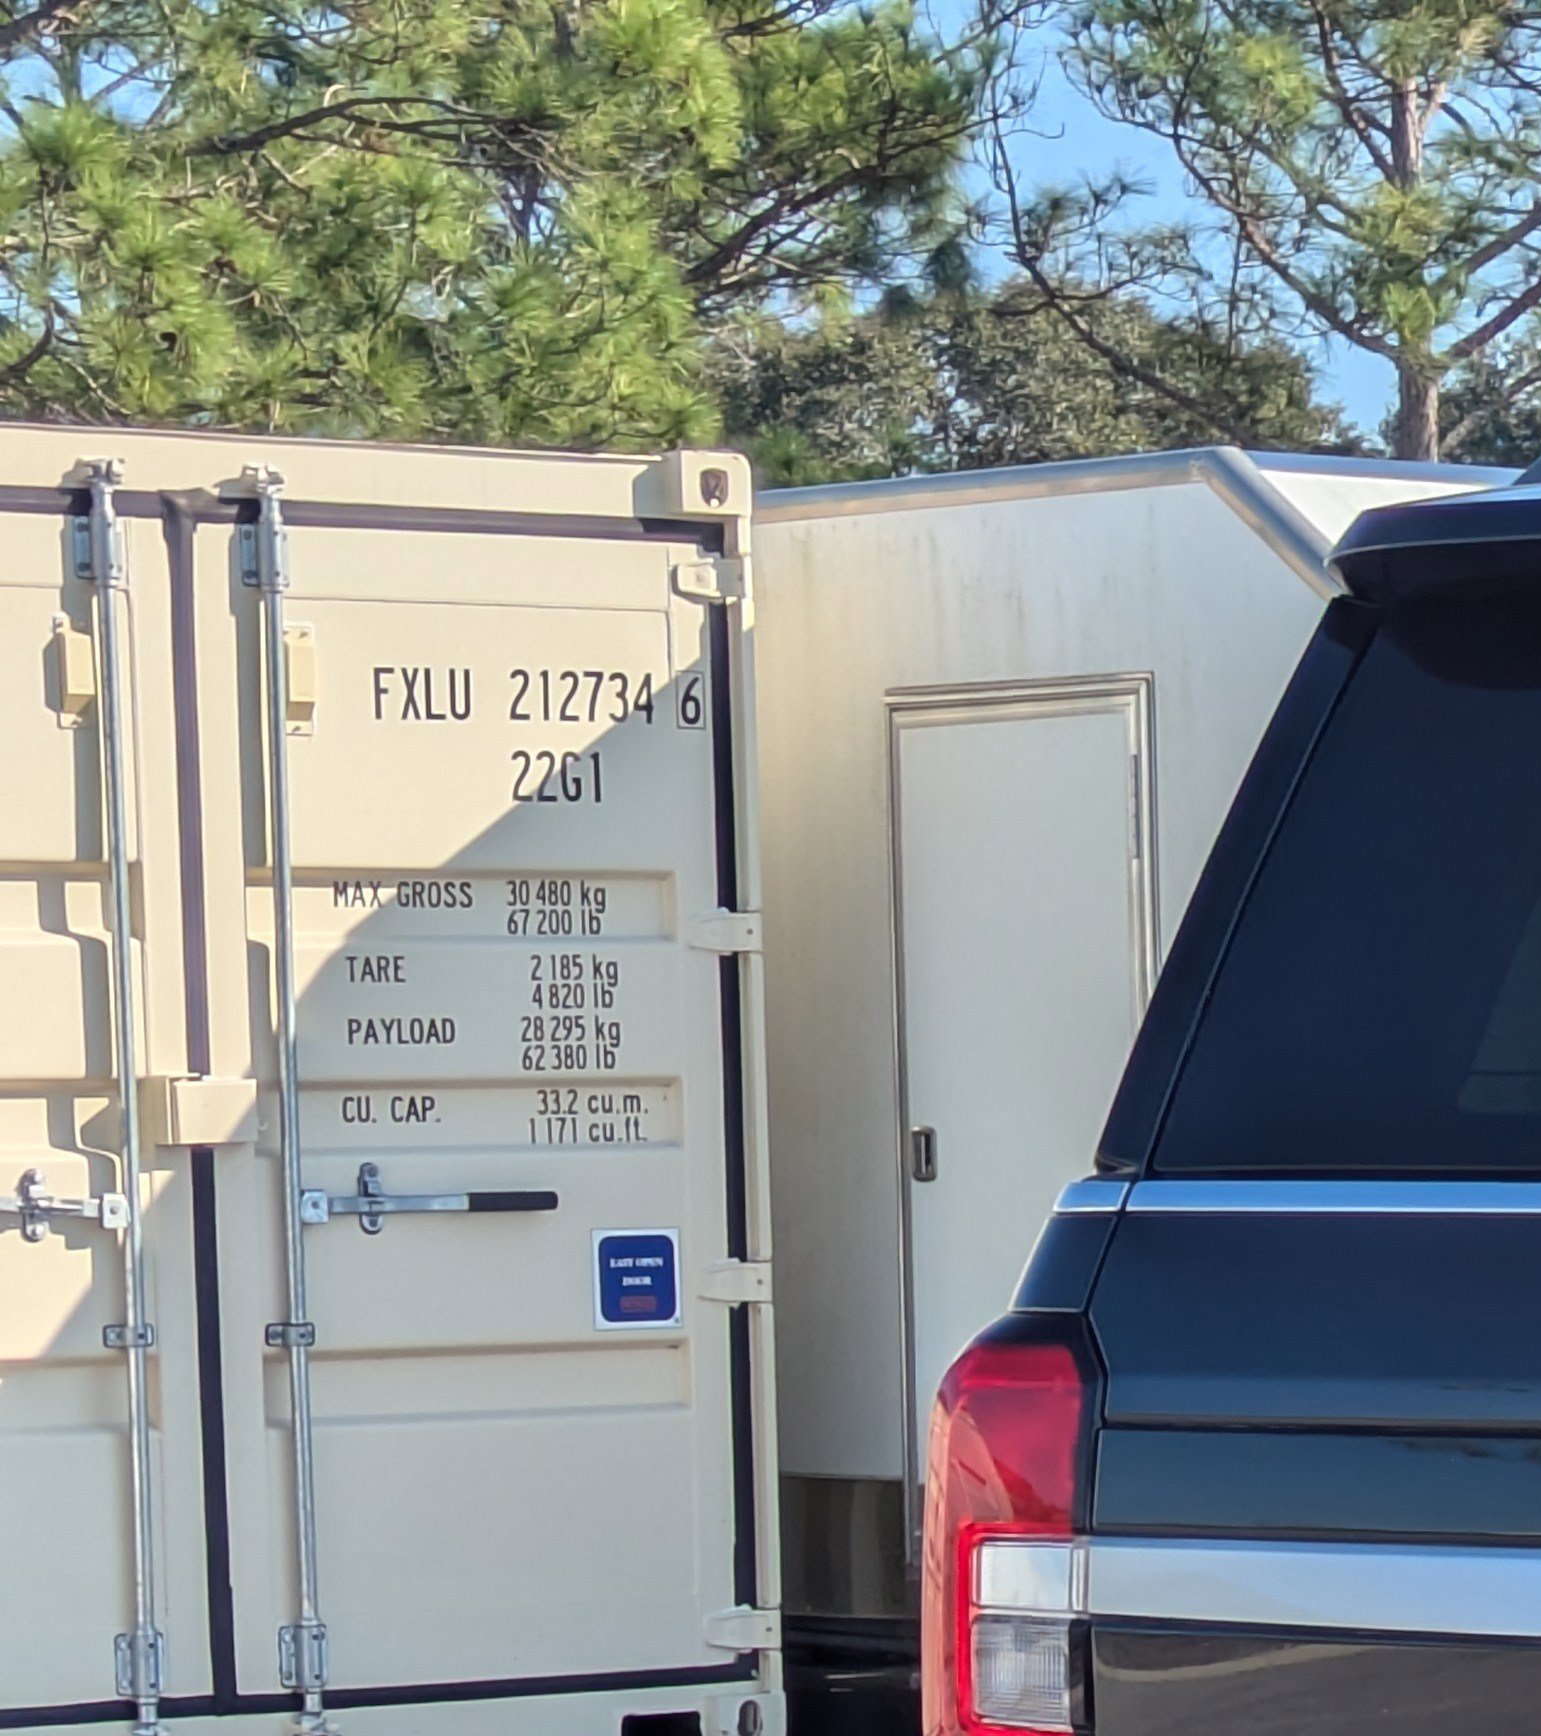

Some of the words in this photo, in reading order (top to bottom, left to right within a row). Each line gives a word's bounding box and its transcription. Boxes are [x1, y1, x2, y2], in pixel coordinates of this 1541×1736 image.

[373, 667, 471, 721] FXLU
[509, 669, 654, 725] 212734
[680, 675, 701, 725] 6
[511, 750, 602, 804] 22G1
[333, 881, 382, 908] MAX
[397, 881, 473, 908] GROSS
[580, 880, 606, 913] kg
[582, 909, 601, 935] lb
[346, 956, 406, 983] TARE
[593, 955, 618, 987] kg
[594, 983, 614, 1009] lb
[348, 1018, 456, 1045] PAYLOAD
[594, 1015, 621, 1047] kg
[595, 1044, 616, 1070] lb
[342, 1096, 377, 1124] CU.
[391, 1096, 442, 1124] CAP.
[537, 1089, 578, 1115] 33.2
